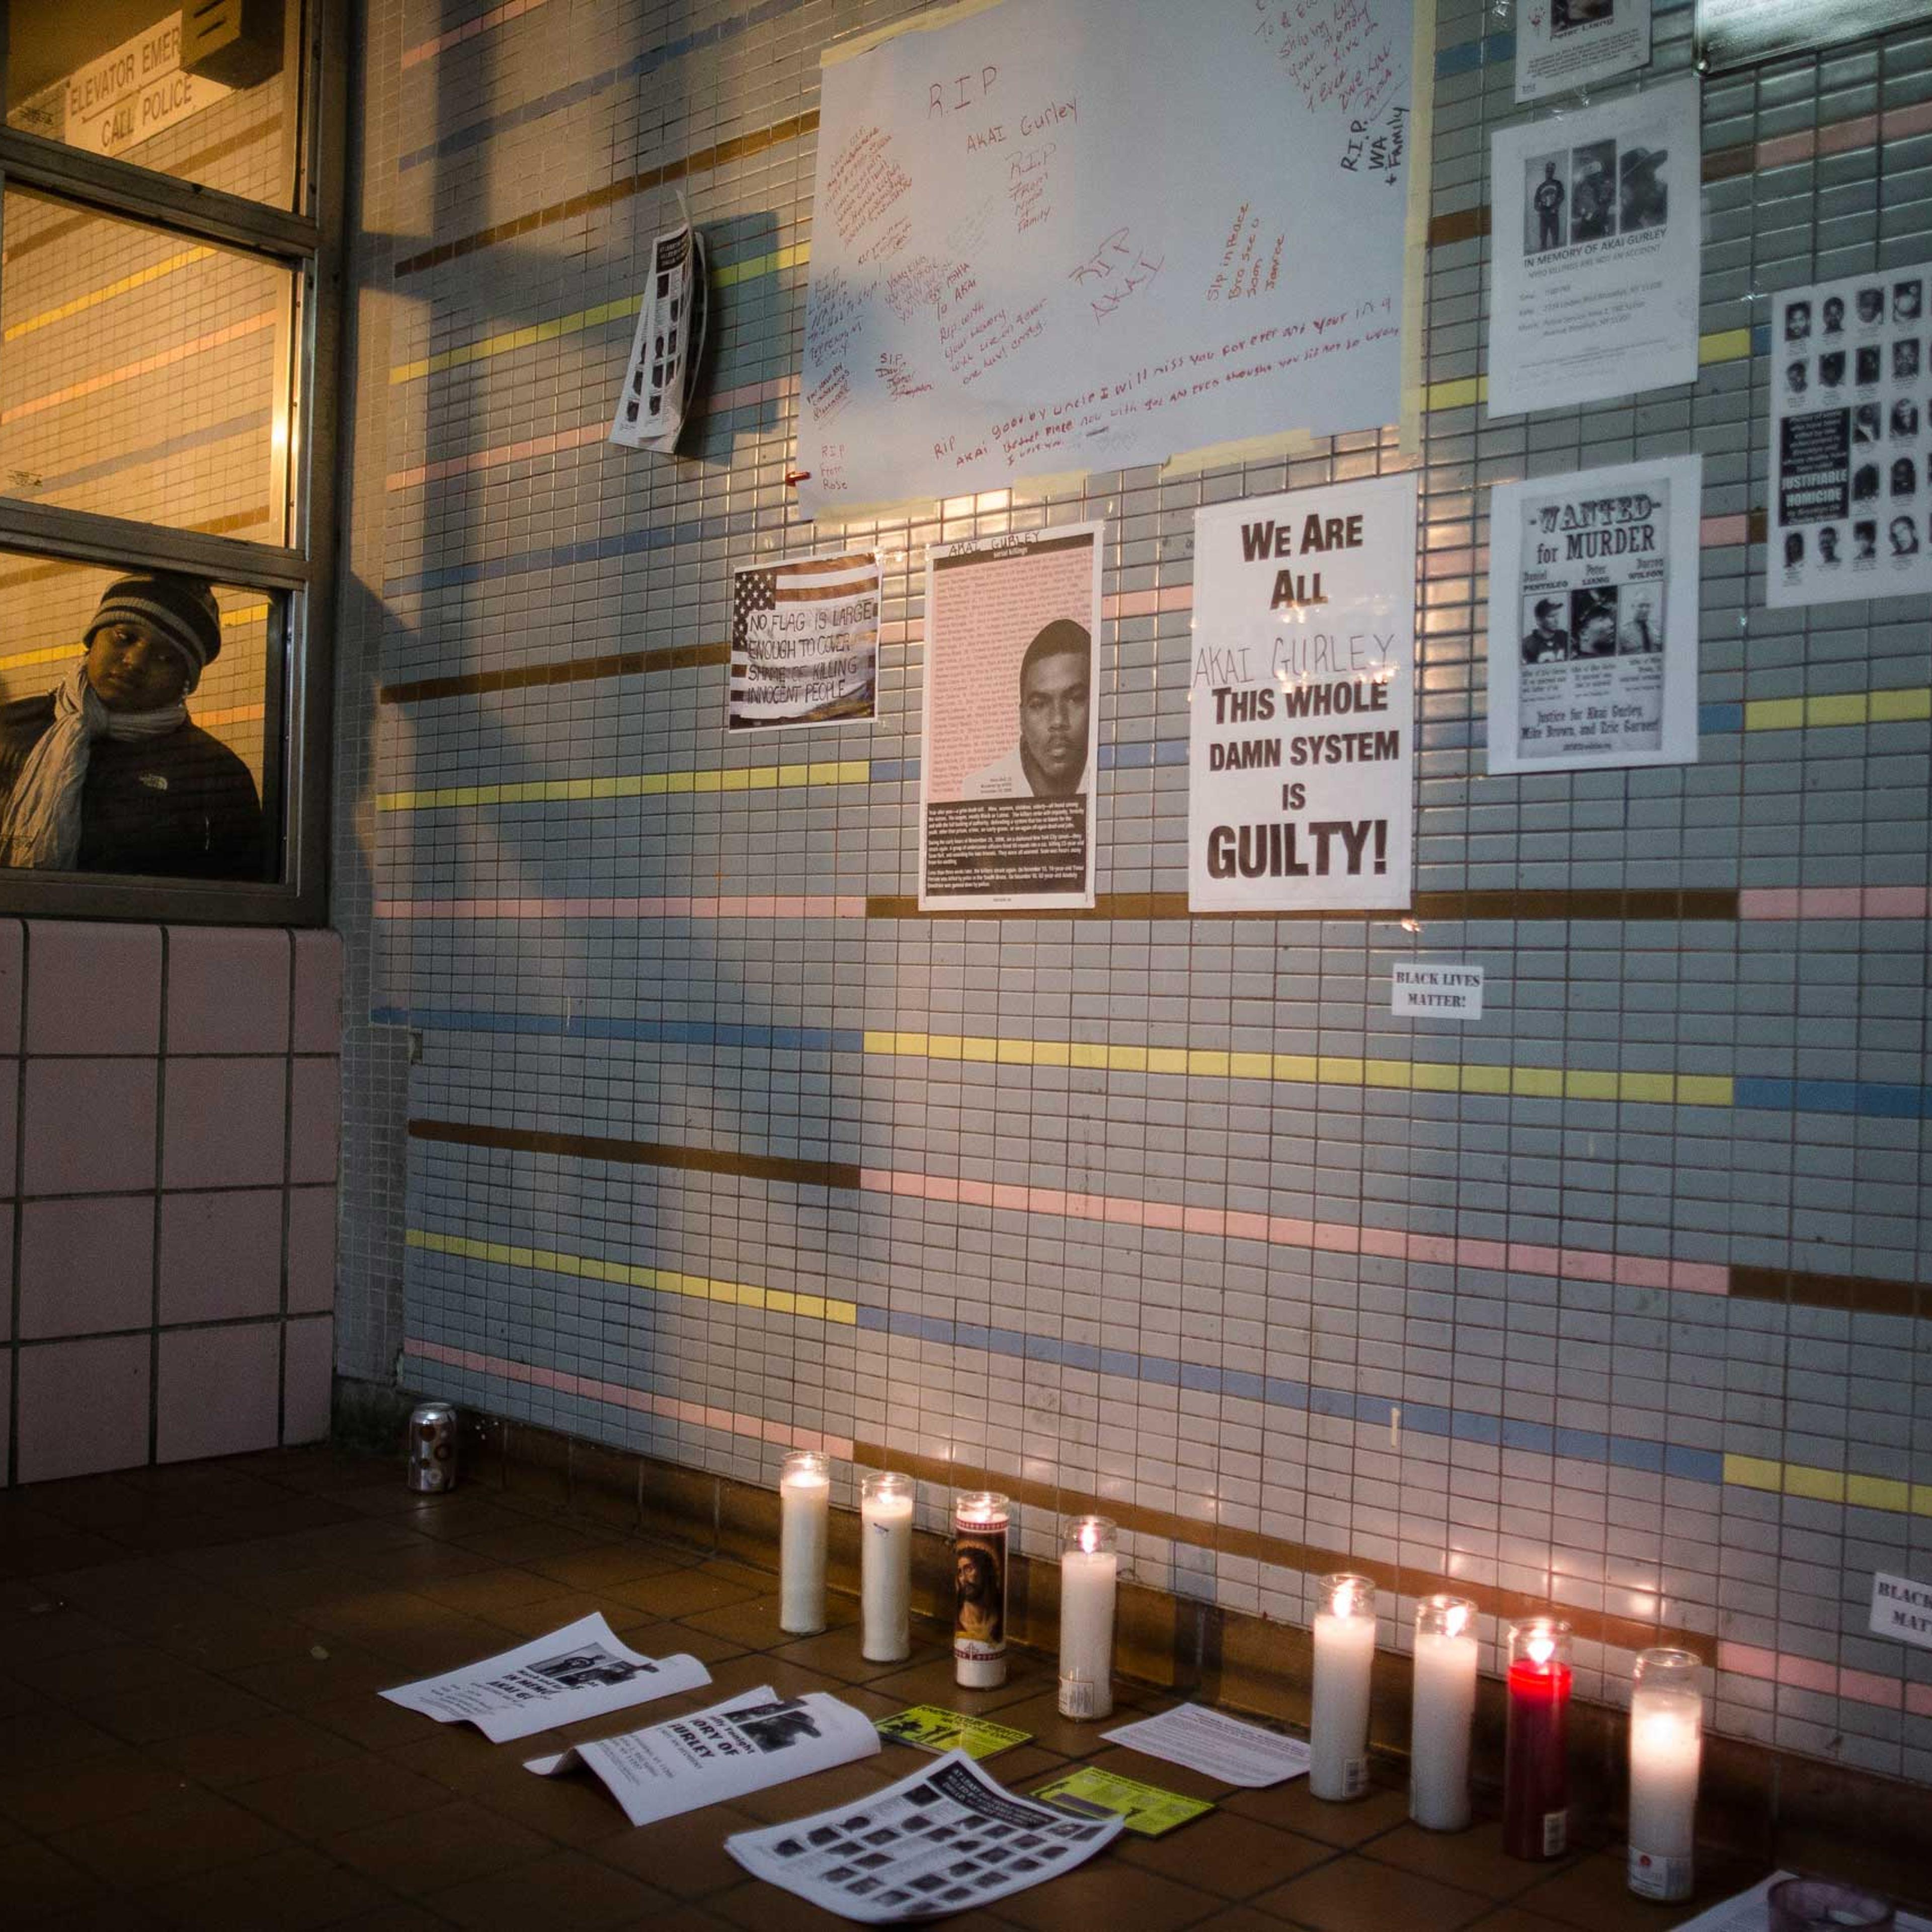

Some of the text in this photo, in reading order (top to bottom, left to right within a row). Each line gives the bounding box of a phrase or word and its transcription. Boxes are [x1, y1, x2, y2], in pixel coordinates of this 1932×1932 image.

[71, 54, 134, 116] ELEVATOR
[102, 75, 192, 148] CALL POLICE
[967, 126, 1006, 153] AKAI
[1524, 228, 1667, 268] IN MEMORY OF AKAI GURLEY
[1782, 469, 1847, 490] JUSTIFIABLE
[1787, 488, 1842, 507] HOMICIDE
[1539, 494, 1652, 533] WANTED
[1537, 524, 1655, 565] for MURDER
[750, 614, 767, 631] NO
[772, 613, 805, 631] FLAG
[833, 600, 873, 626] LARGE
[748, 632, 851, 660] ENOUGH TO COVER
[813, 657, 857, 679] KILLING
[1193, 634, 1395, 688] AKAI GURLEY
[747, 679, 847, 703] INNOCENT PEOPLE
[1285, 680, 1388, 718] WHOLE
[1210, 730, 1400, 772] DAMN SYSTEM
[1282, 783, 1306, 811] IS
[1207, 820, 1388, 879] GUILTY!
[1396, 972, 1480, 987] BLACK LIVES
[1408, 993, 1466, 1008] MATTER!
[718, 1743, 740, 1755] OF
